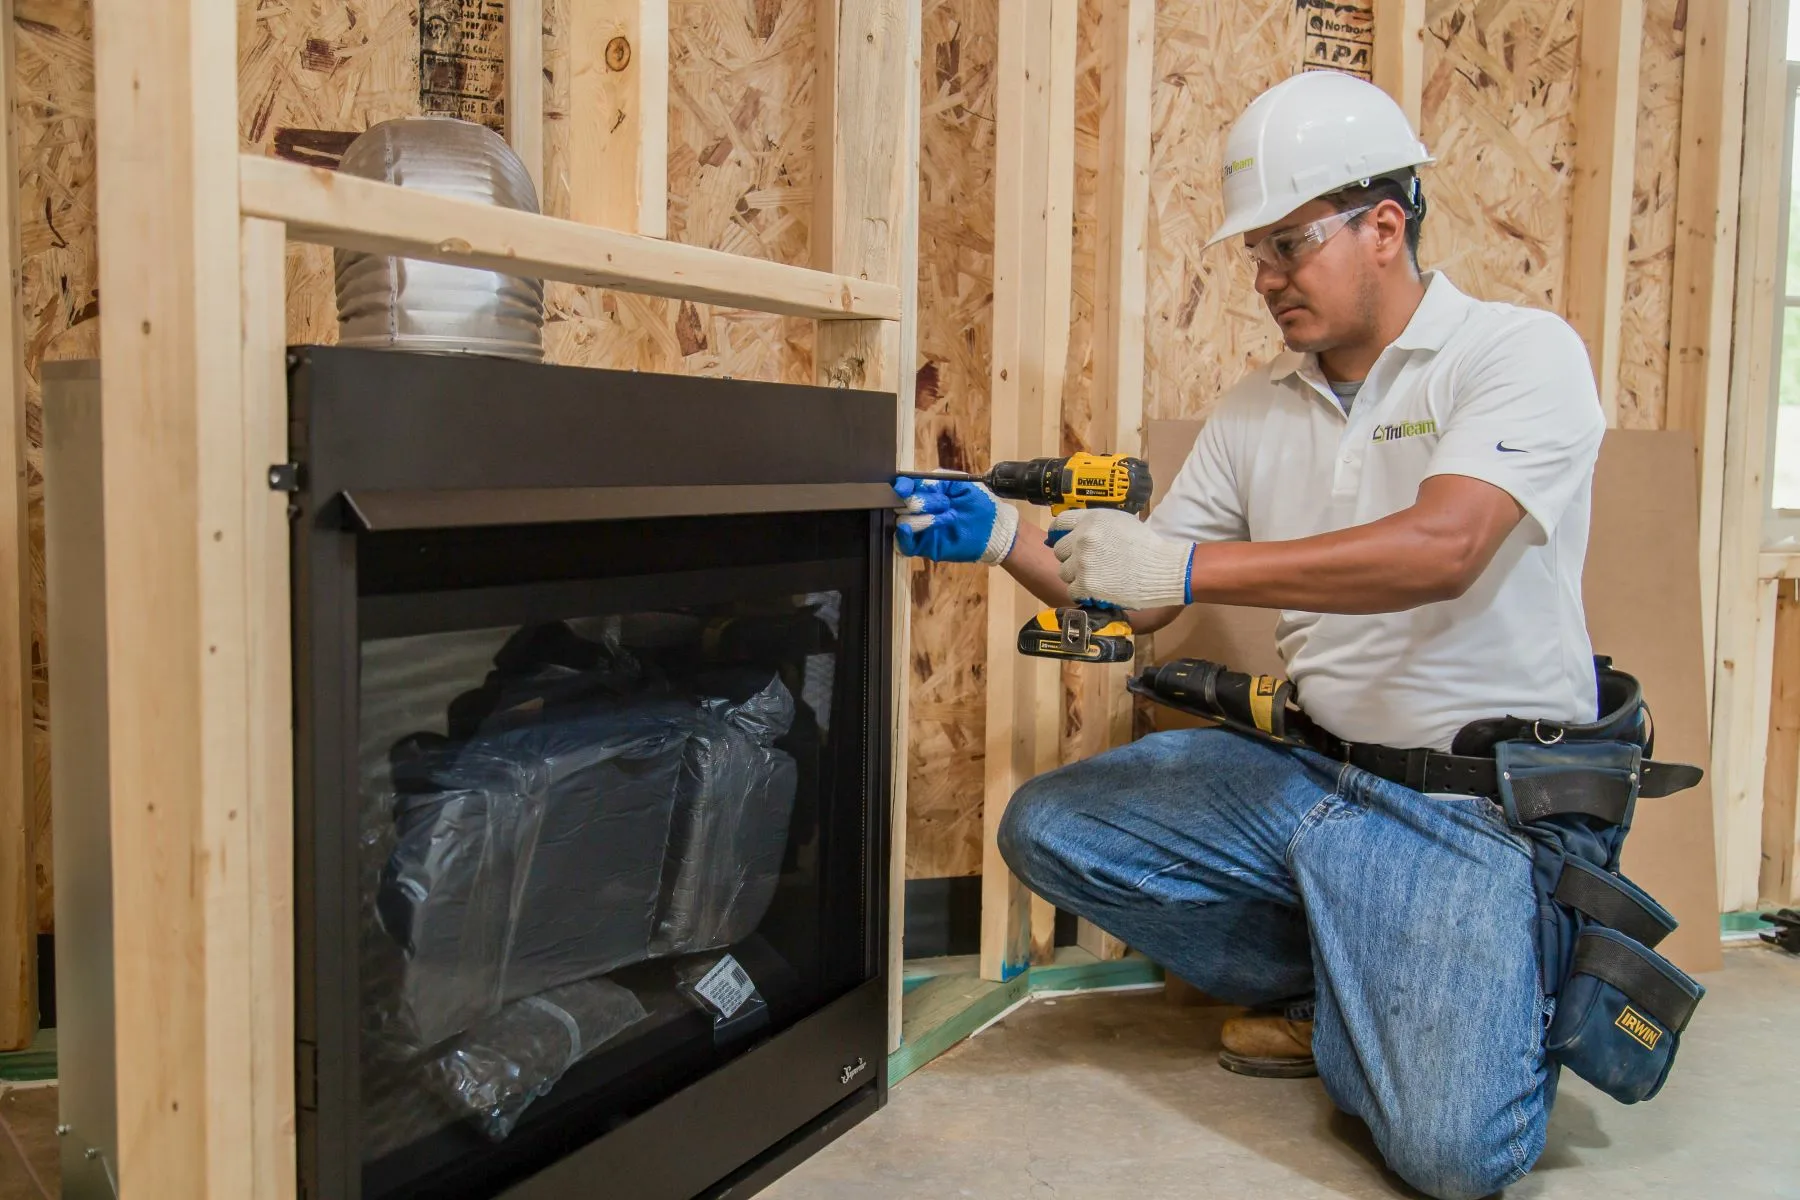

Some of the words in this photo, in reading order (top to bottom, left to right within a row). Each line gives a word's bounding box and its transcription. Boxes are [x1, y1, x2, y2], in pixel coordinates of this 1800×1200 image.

[1314, 41, 1368, 66] APA
[1224, 157, 1254, 176] TruTeam
[1384, 420, 1437, 441] TruTeam
[1621, 1012, 1658, 1045] IRWIN
